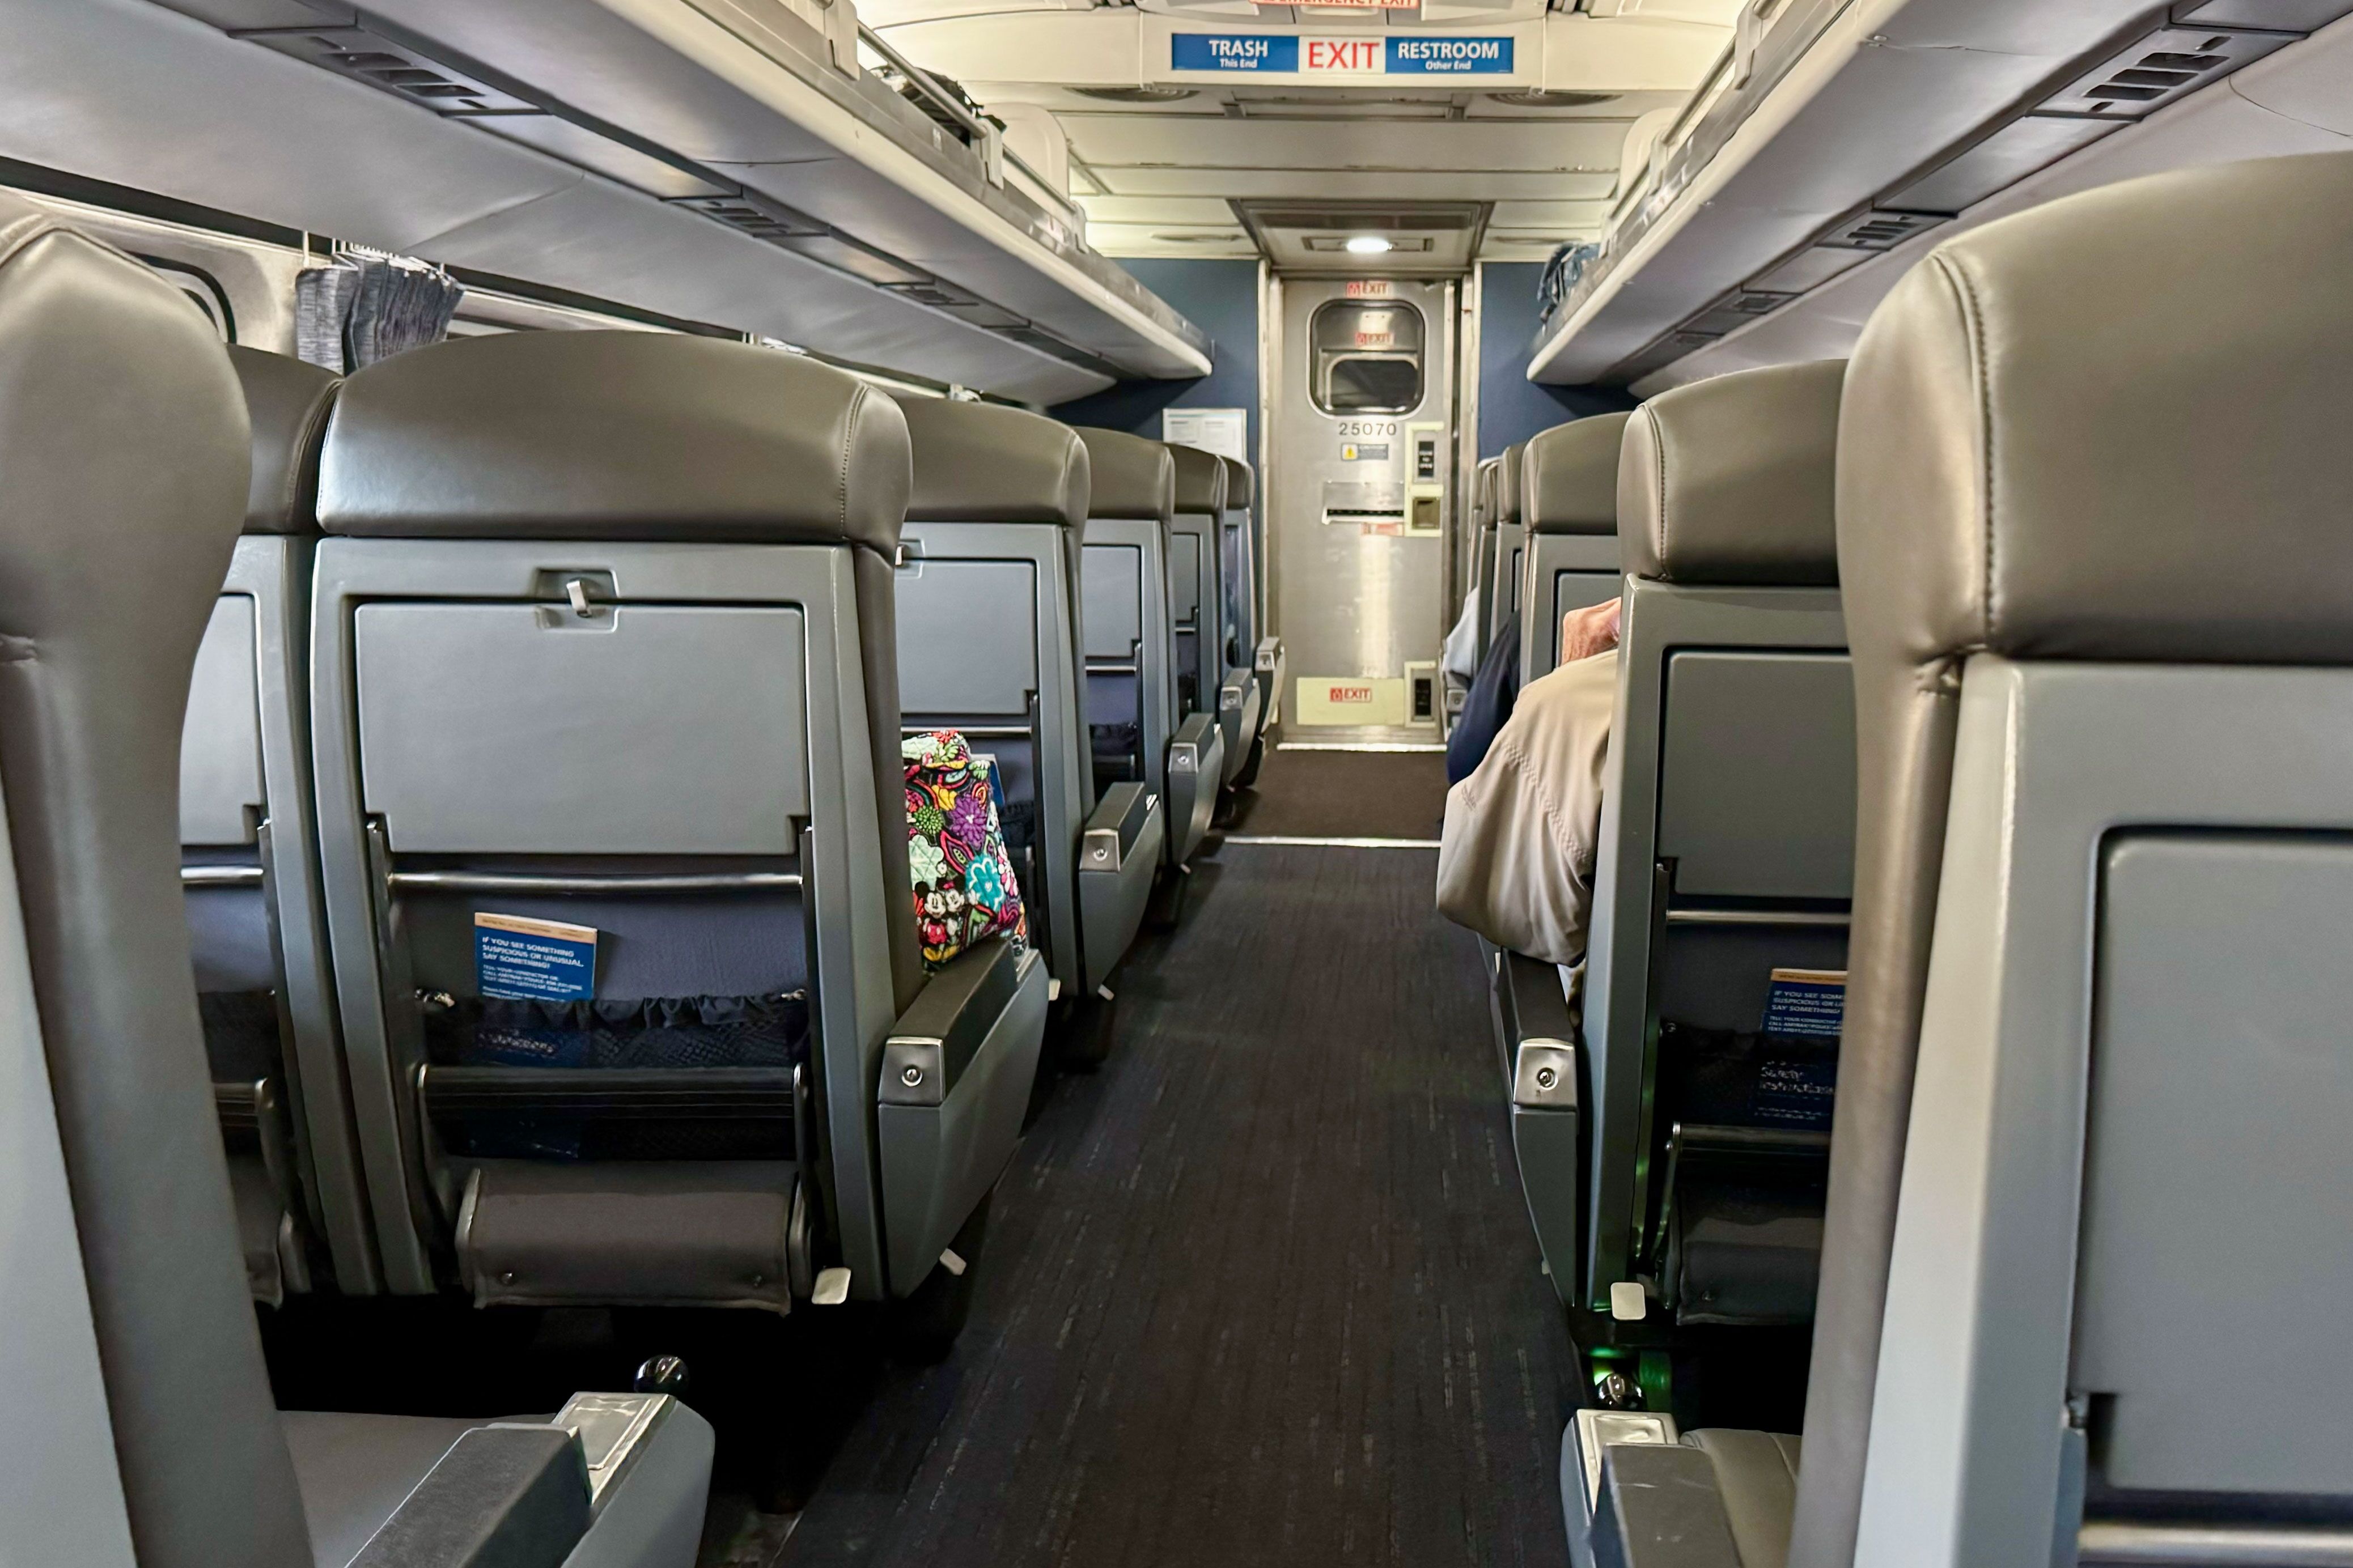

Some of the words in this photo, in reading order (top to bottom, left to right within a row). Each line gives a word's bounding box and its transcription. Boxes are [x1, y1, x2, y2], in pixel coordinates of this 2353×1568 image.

[1209, 40, 1268, 57] TRASH
[1308, 41, 1380, 69] EXIT
[1398, 42, 1499, 59] RESTROOM
[1220, 58, 1238, 68] This
[1240, 58, 1258, 68] End
[1425, 60, 1452, 70] Other
[1453, 60, 1472, 70] End
[1362, 282, 1388, 294] EXIT
[1338, 422, 1397, 436] 25070
[1345, 687, 1370, 699] EXIT
[482, 944, 528, 958] SUSPICIOUS
[490, 938, 509, 946] YOU
[527, 944, 574, 957] SOMETHING
[482, 952, 498, 961] SAY
